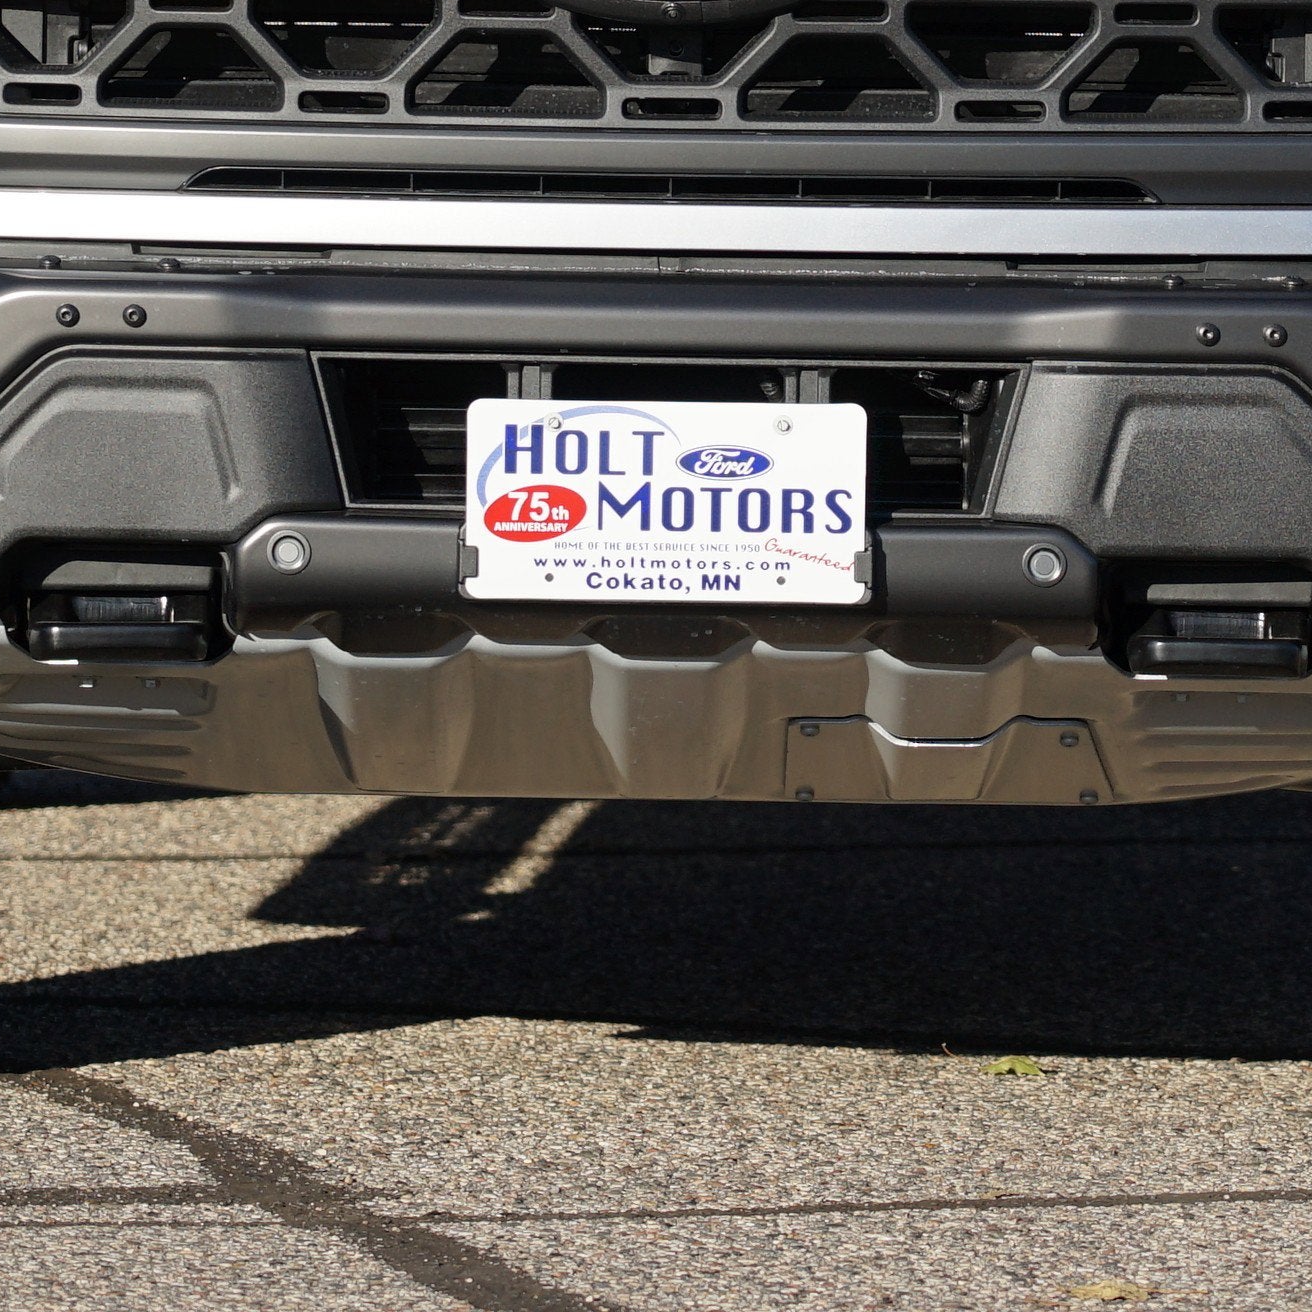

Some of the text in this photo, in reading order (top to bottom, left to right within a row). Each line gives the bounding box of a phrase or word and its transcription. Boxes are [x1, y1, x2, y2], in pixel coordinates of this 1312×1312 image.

[503, 423, 666, 476] HOLT
[694, 449, 756, 475] Ford
[507, 491, 570, 522] 75th
[597, 481, 853, 535] MOTORS
[493, 521, 569, 533] ANNIVERSARY
[554, 541, 761, 553] HOME OF THE BEST SERVICE SINCE 1950
[764, 537, 856, 571] Guaranteed
[533, 555, 792, 572] www.holtmotors.com
[585, 571, 741, 595] Cokato, MN
